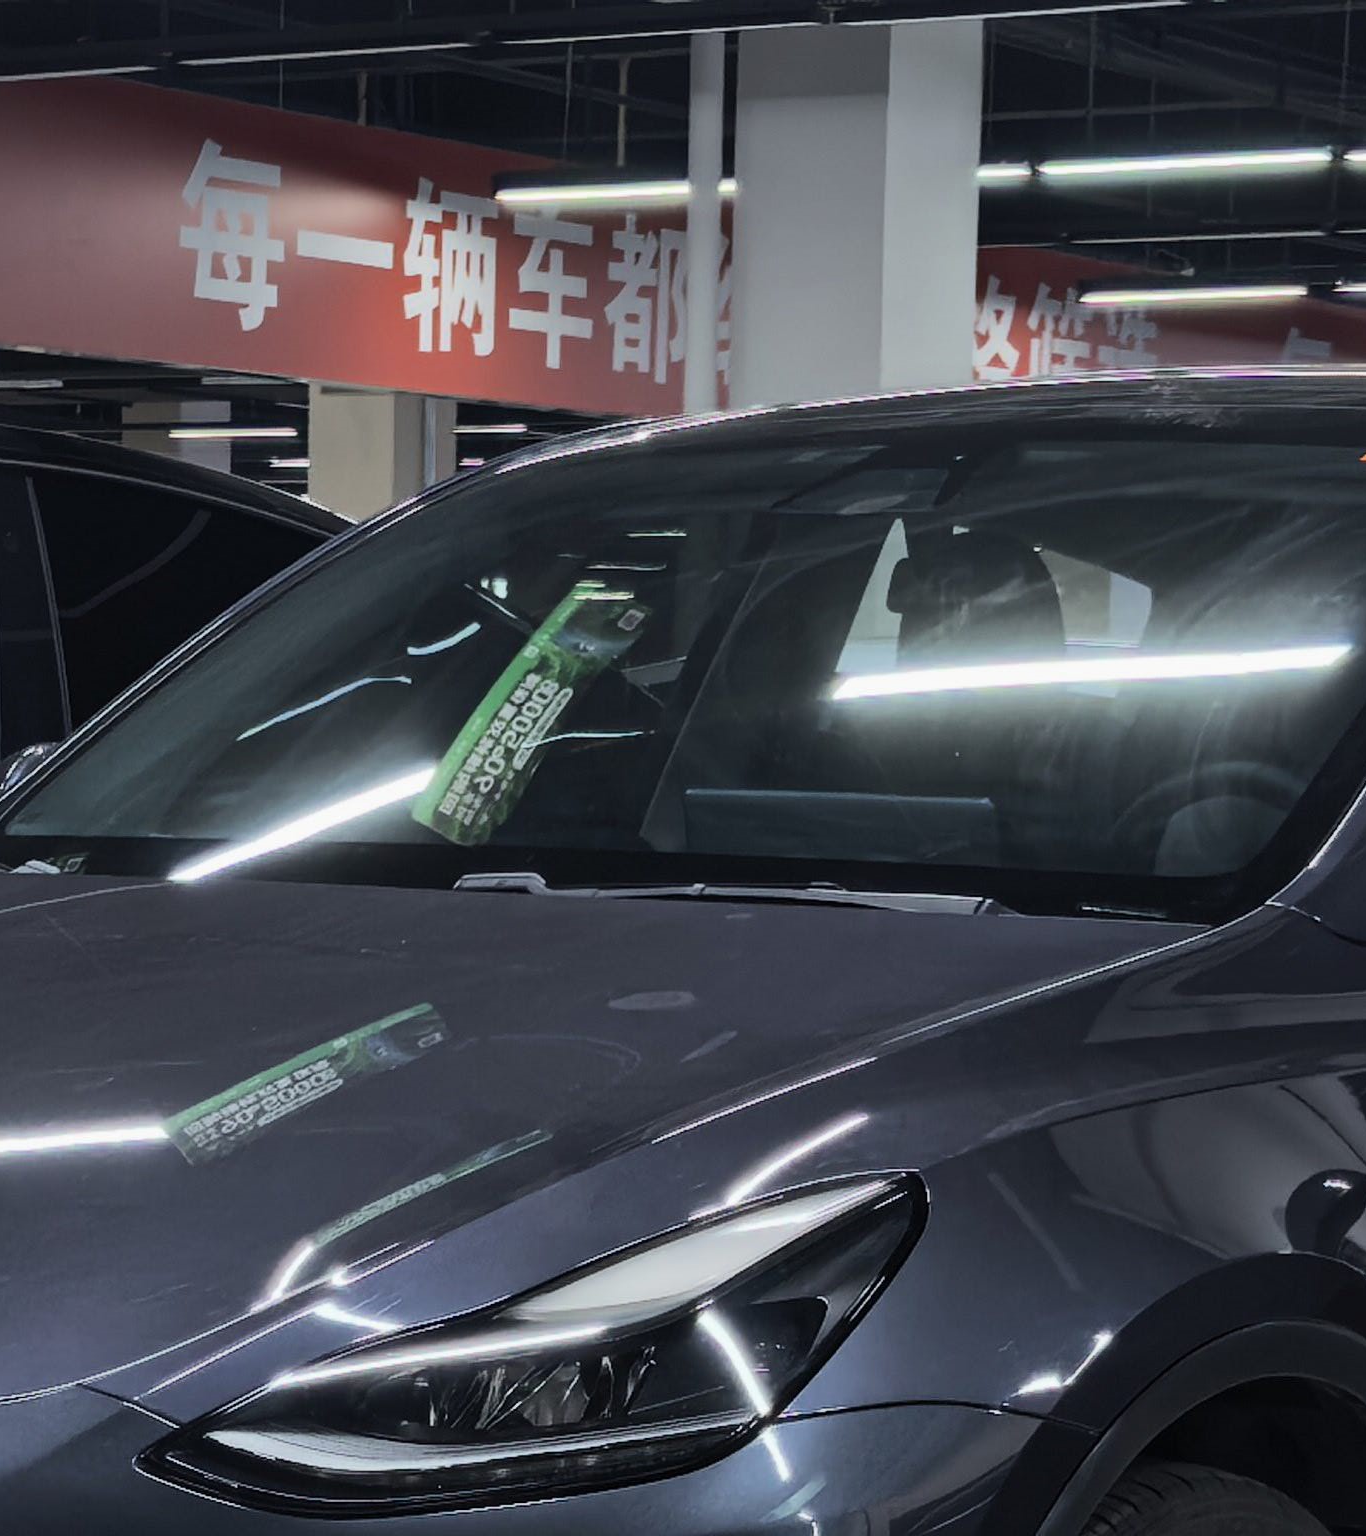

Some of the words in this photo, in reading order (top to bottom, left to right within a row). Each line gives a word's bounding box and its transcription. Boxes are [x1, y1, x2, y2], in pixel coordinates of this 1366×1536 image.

[180, 138, 732, 387] 每一辆车都
